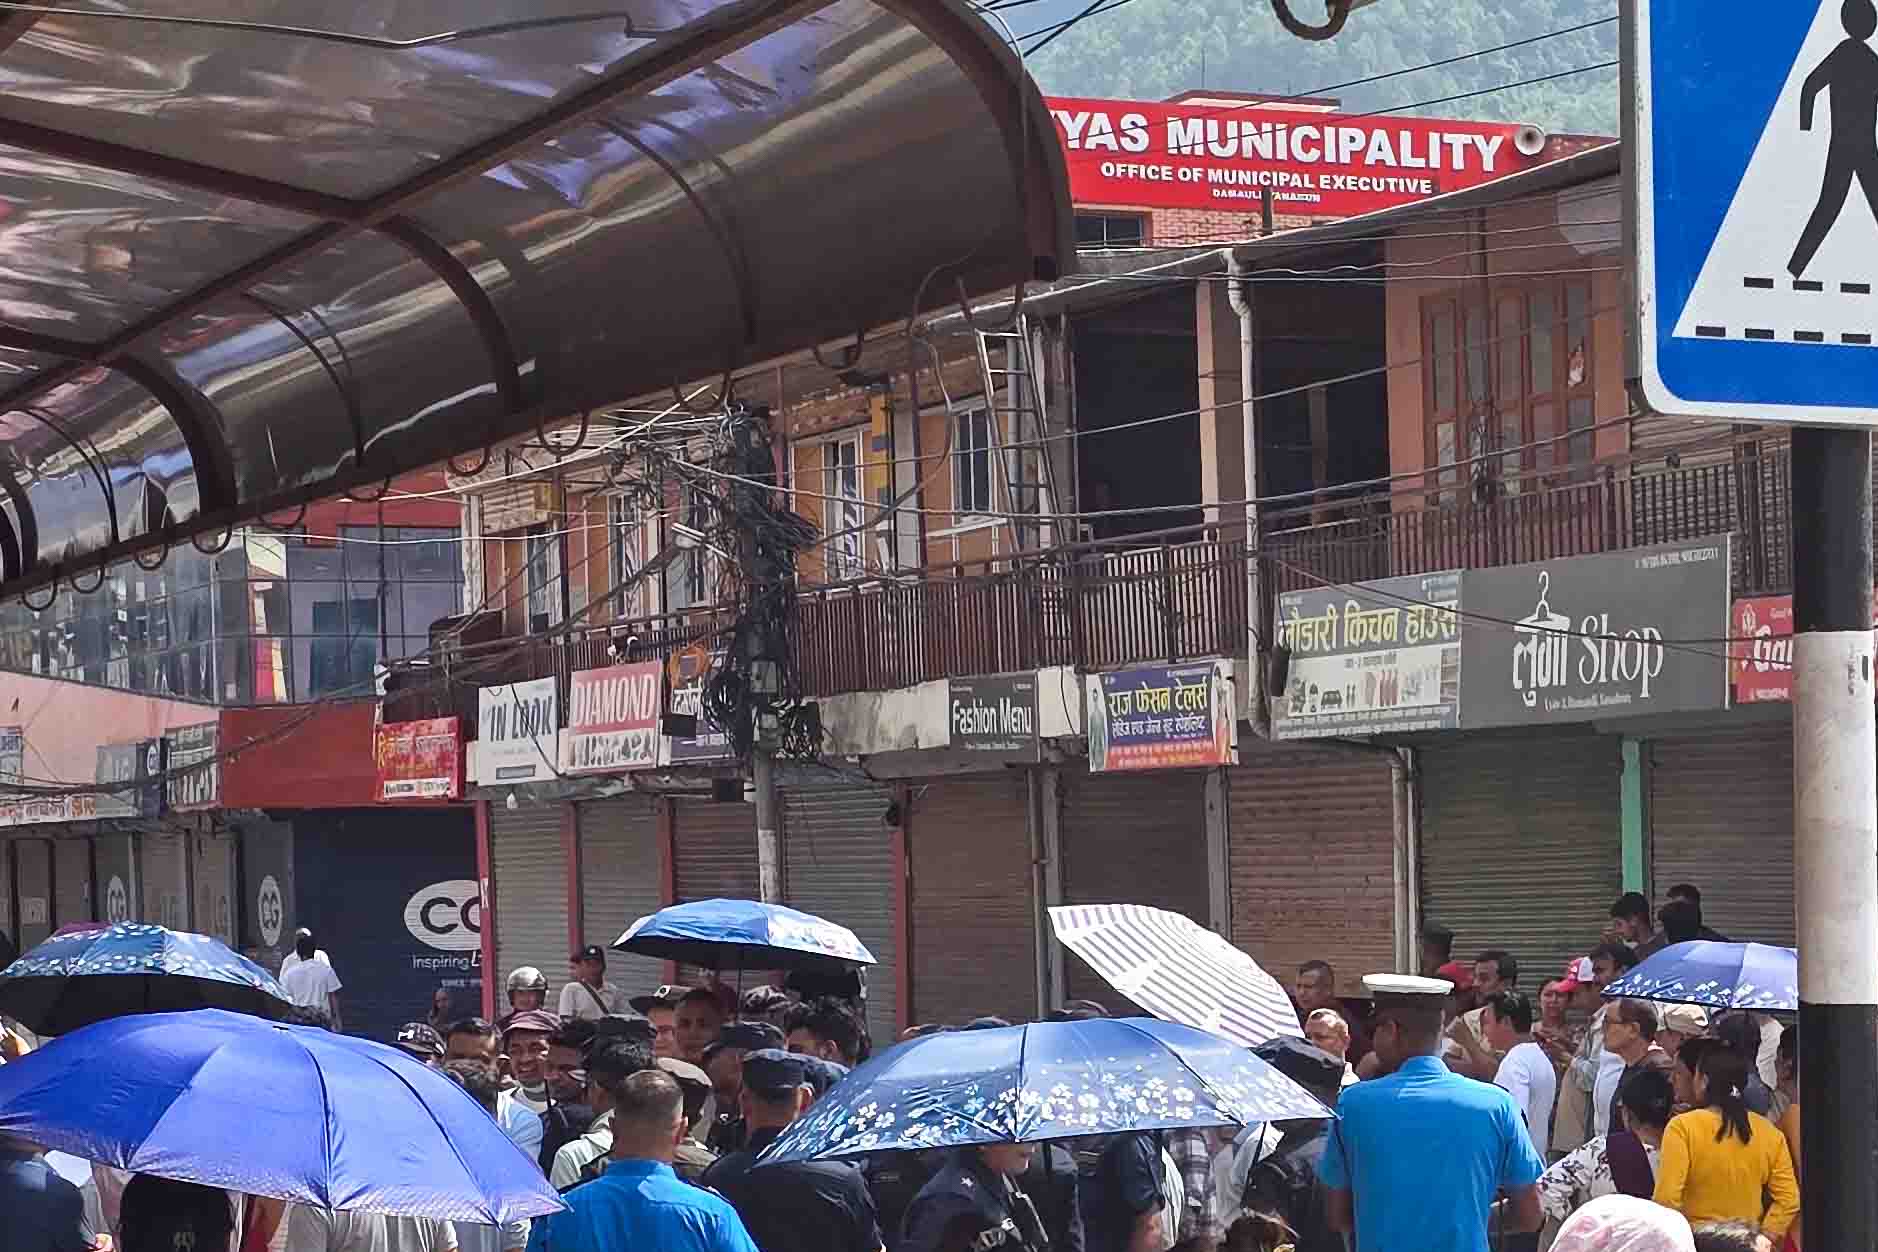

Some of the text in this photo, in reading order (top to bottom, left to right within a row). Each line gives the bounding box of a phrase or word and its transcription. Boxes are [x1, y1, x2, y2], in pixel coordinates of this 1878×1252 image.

[1052, 111, 1505, 172] YAS MUNICIPALITY
[1101, 161, 1433, 195] OFFICE OF MUNICIPAL EXECUTIVE
[1344, 599, 1401, 648] किचन
[1578, 613, 1664, 698] Shop
[512, 695, 553, 739] LOOK
[574, 674, 657, 728] DIAMOND
[952, 697, 1032, 735] Fashion Menu
[1108, 691, 1132, 718] राज
[1135, 681, 1170, 714] फेसन
